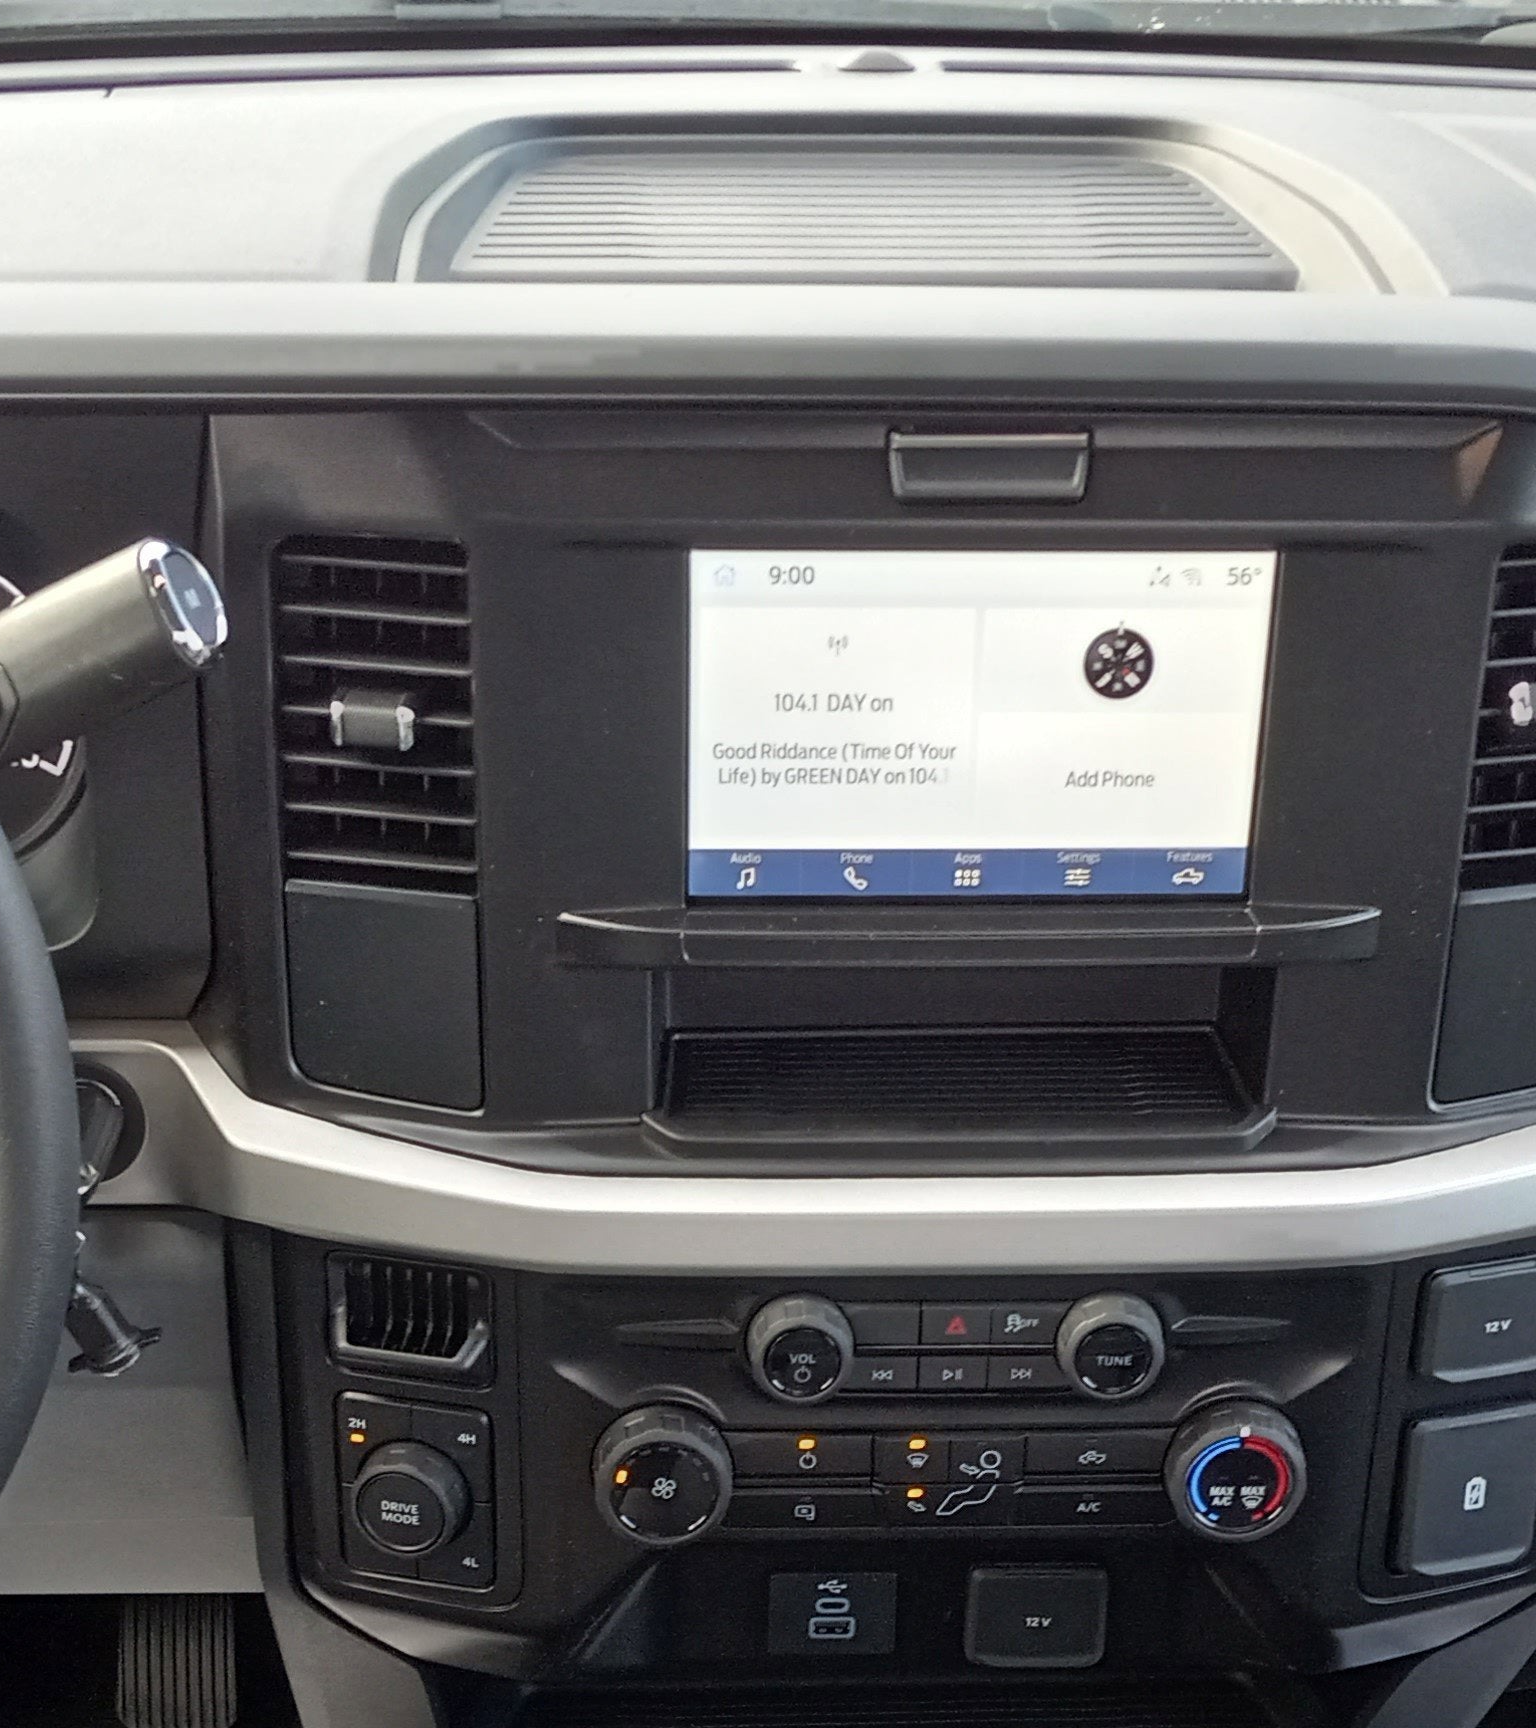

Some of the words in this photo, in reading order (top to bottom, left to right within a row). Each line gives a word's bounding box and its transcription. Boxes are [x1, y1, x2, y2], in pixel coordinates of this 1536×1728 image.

[769, 565, 815, 586] 9:00
[1227, 567, 1262, 586] 56°
[774, 694, 818, 712] 104.1
[827, 694, 866, 712] DAY
[870, 698, 894, 712] on
[713, 743, 757, 759] Good
[761, 743, 837, 759] Riddance
[842, 742, 891, 762] (Time
[894, 743, 915, 759] Of
[919, 743, 957, 759] Your
[718, 767, 756, 787] Life)
[761, 767, 781, 787] by
[784, 768, 842, 784] GREEN
[846, 768, 881, 784] DAY
[884, 771, 906, 784] on
[1065, 771, 1098, 788] Add
[1102, 771, 1154, 788] Phone
[730, 852, 762, 864] Audio
[840, 852, 874, 864] Phone
[954, 852, 982, 865] Apps
[1056, 852, 1101, 864] Settings
[1166, 851, 1212, 863] Features
[1484, 1319, 1513, 1334] 12V
[789, 1353, 817, 1365] VOL
[1096, 1355, 1133, 1366] TUNE
[348, 1417, 366, 1430] 2H
[457, 1432, 476, 1445] 4H
[1209, 1486, 1236, 1496] MAX
[1240, 1486, 1266, 1496] MAX
[381, 1500, 420, 1515] DRIVE
[1077, 1501, 1101, 1513] A/C
[381, 1511, 420, 1526] MODE
[462, 1556, 479, 1568] 4L
